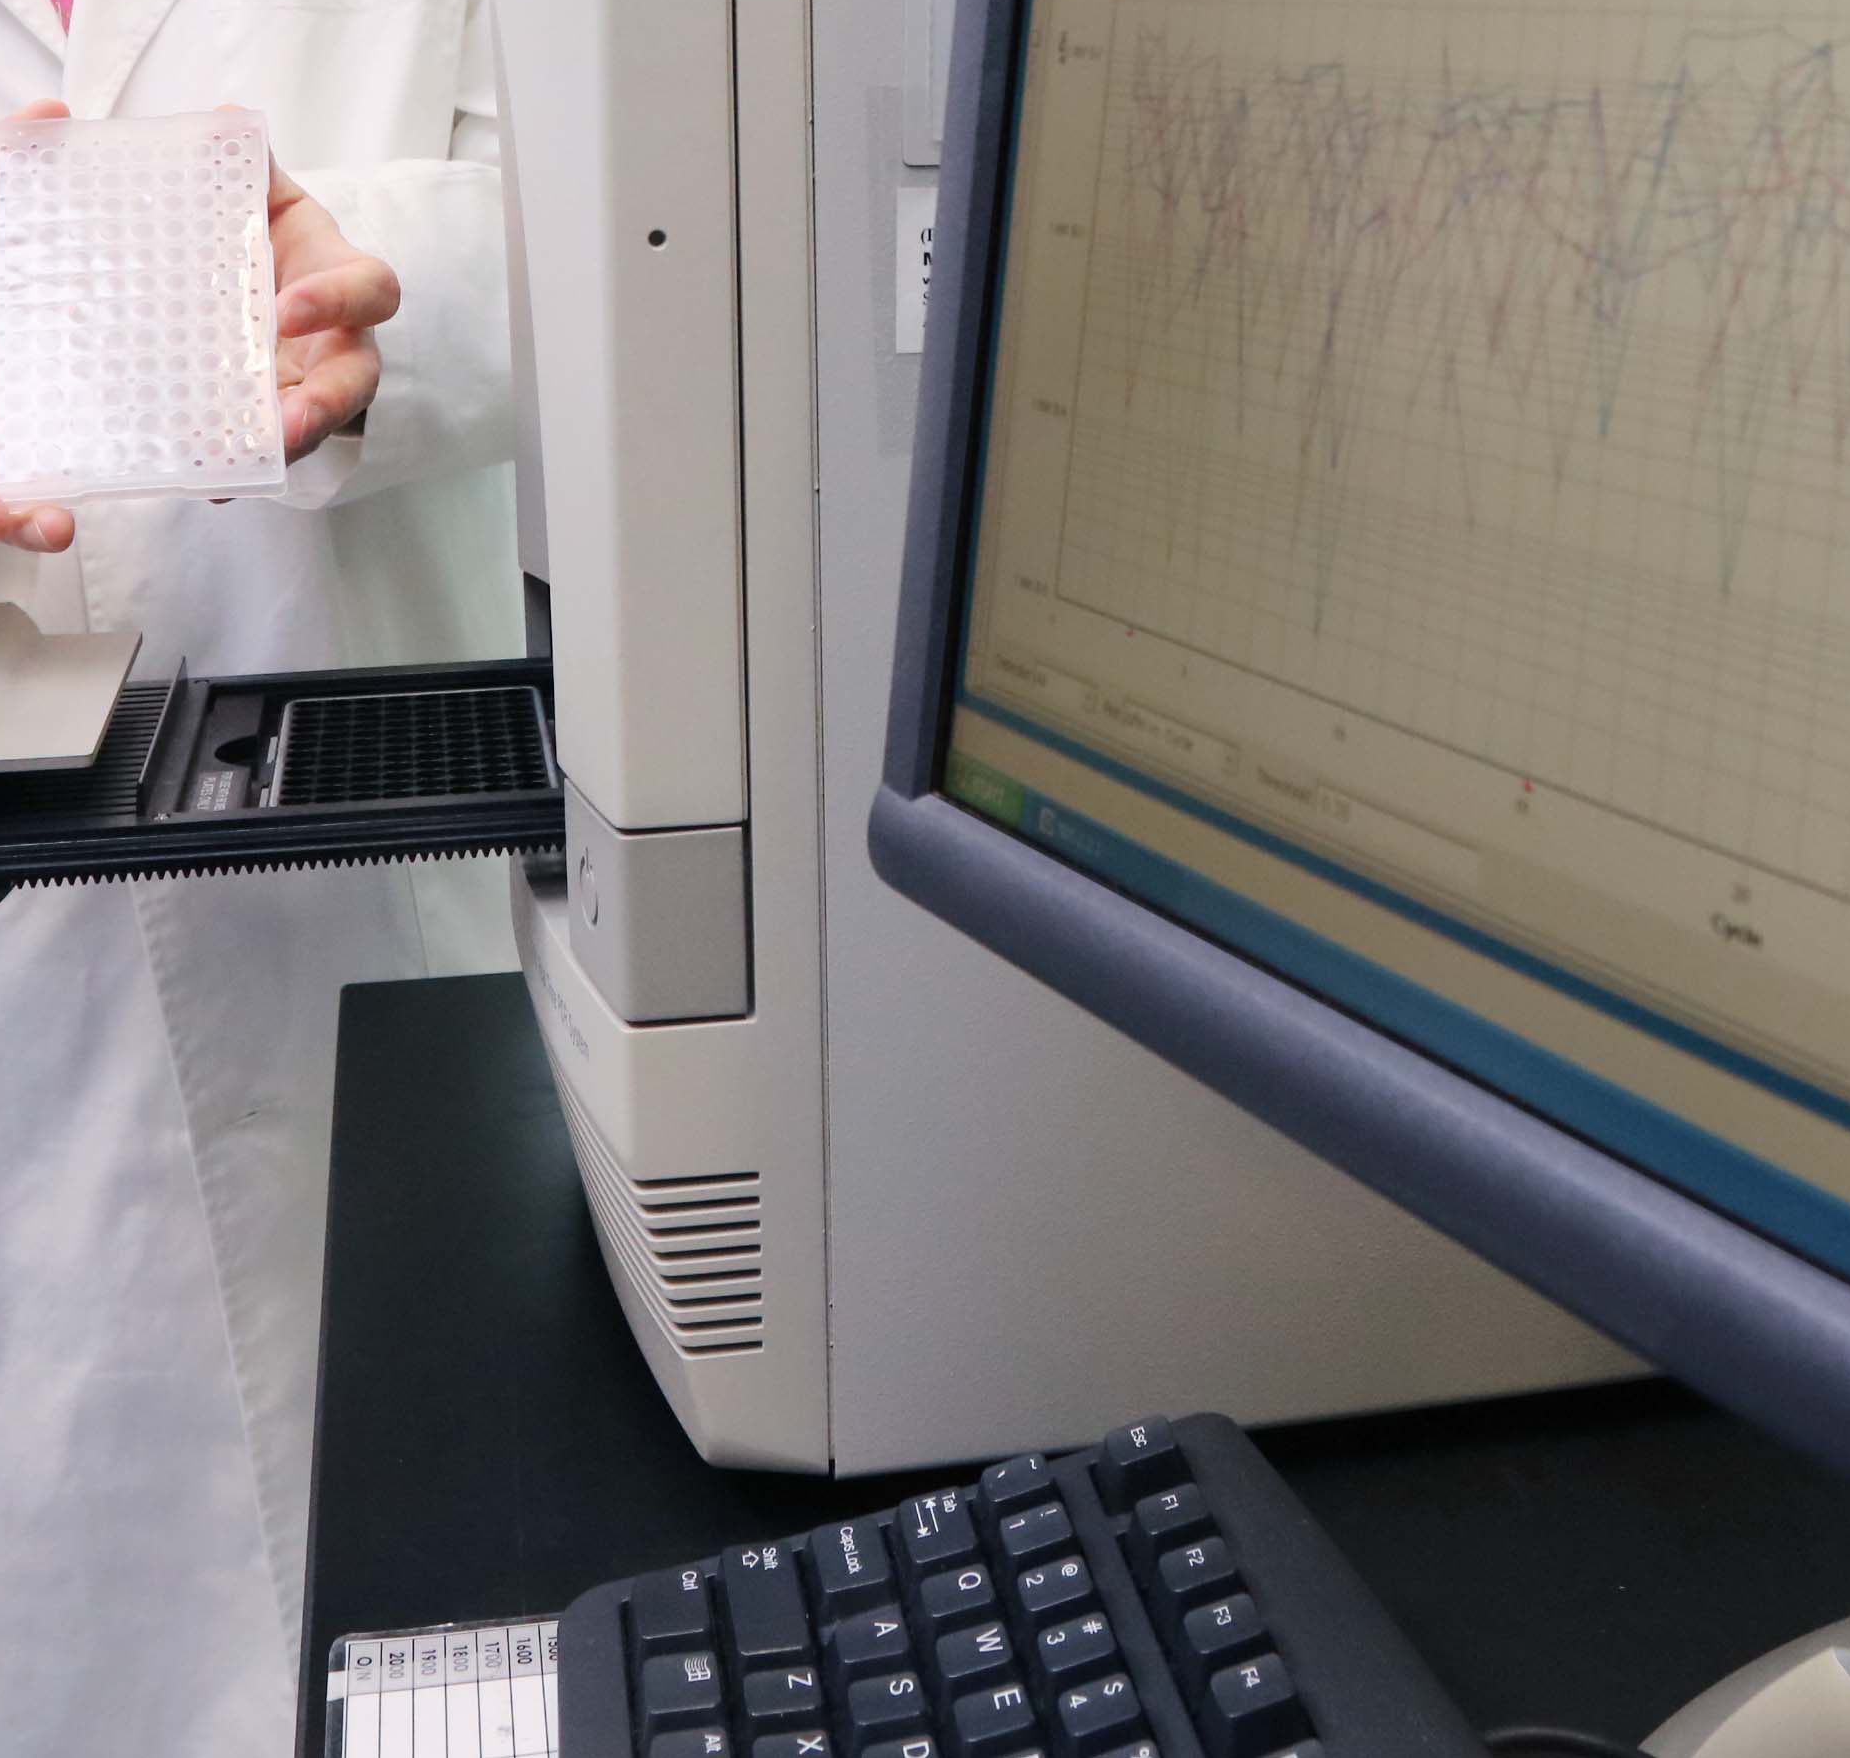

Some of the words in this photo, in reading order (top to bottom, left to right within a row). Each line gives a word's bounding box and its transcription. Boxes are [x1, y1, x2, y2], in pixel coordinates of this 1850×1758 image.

[1129, 1425, 1147, 1449] Esc
[941, 1492, 957, 1513] Tab
[1160, 1493, 1180, 1512] F1
[1008, 1518, 1026, 1531] 1
[839, 1525, 856, 1552] Caps
[762, 1547, 779, 1571] Shift
[844, 1551, 864, 1575] Lock
[1185, 1547, 1205, 1568] F2
[681, 1570, 699, 1591] Ctrl
[1061, 1563, 1079, 1578] @
[957, 1571, 983, 1592] Q
[1025, 1575, 1044, 1588] 2
[1212, 1605, 1233, 1626] F3
[873, 1620, 900, 1638] A
[1081, 1619, 1104, 1636] #
[975, 1628, 1004, 1653] W
[1045, 1631, 1066, 1646] 3
[452, 1645, 469, 1673] 1800
[484, 1641, 502, 1669] 1700
[516, 1637, 533, 1665] 1600
[389, 1651, 405, 1680] 2000
[421, 1649, 437, 1677] 1900
[787, 1672, 813, 1690] Z
[888, 1677, 915, 1697] S
[1239, 1665, 1261, 1689] F4
[992, 1688, 1023, 1710] E
[1068, 1693, 1089, 1710] 4
[704, 1733, 722, 1754] Alt
[796, 1735, 824, 1755] X
[902, 1739, 931, 1758] D
